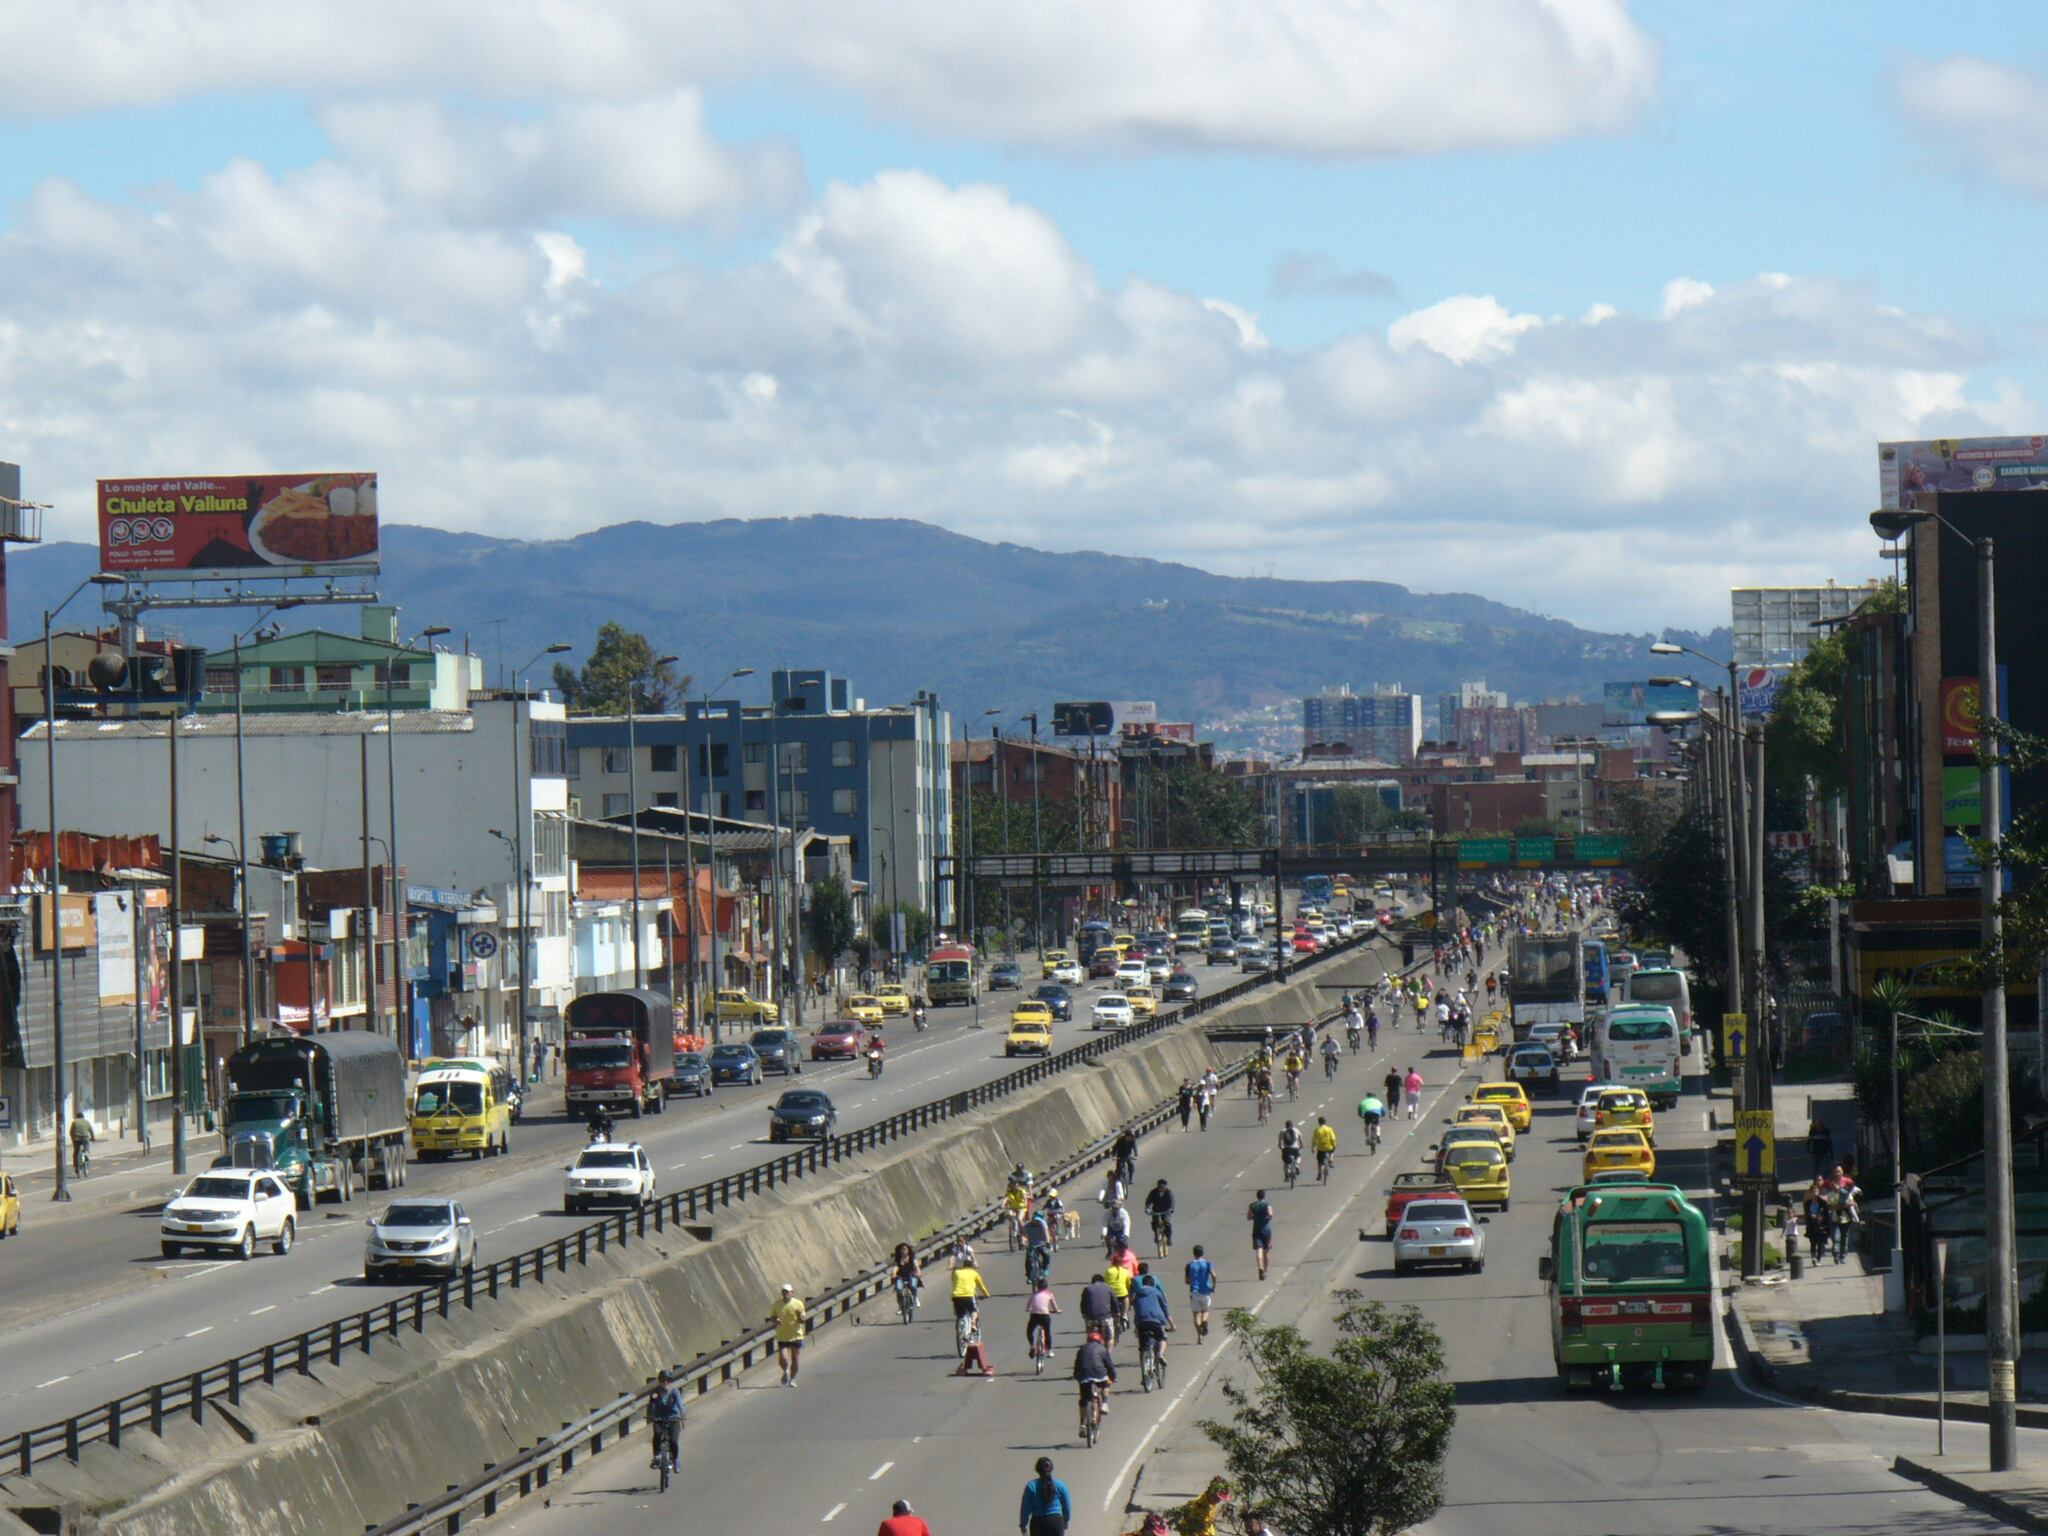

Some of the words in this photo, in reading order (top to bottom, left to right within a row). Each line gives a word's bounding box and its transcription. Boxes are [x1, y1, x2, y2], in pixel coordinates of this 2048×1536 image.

[105, 483, 120, 492] Lo
[123, 481, 159, 493] mejor
[161, 480, 180, 491] del
[106, 497, 176, 515] Chuleta
[180, 495, 248, 512] Valluna
